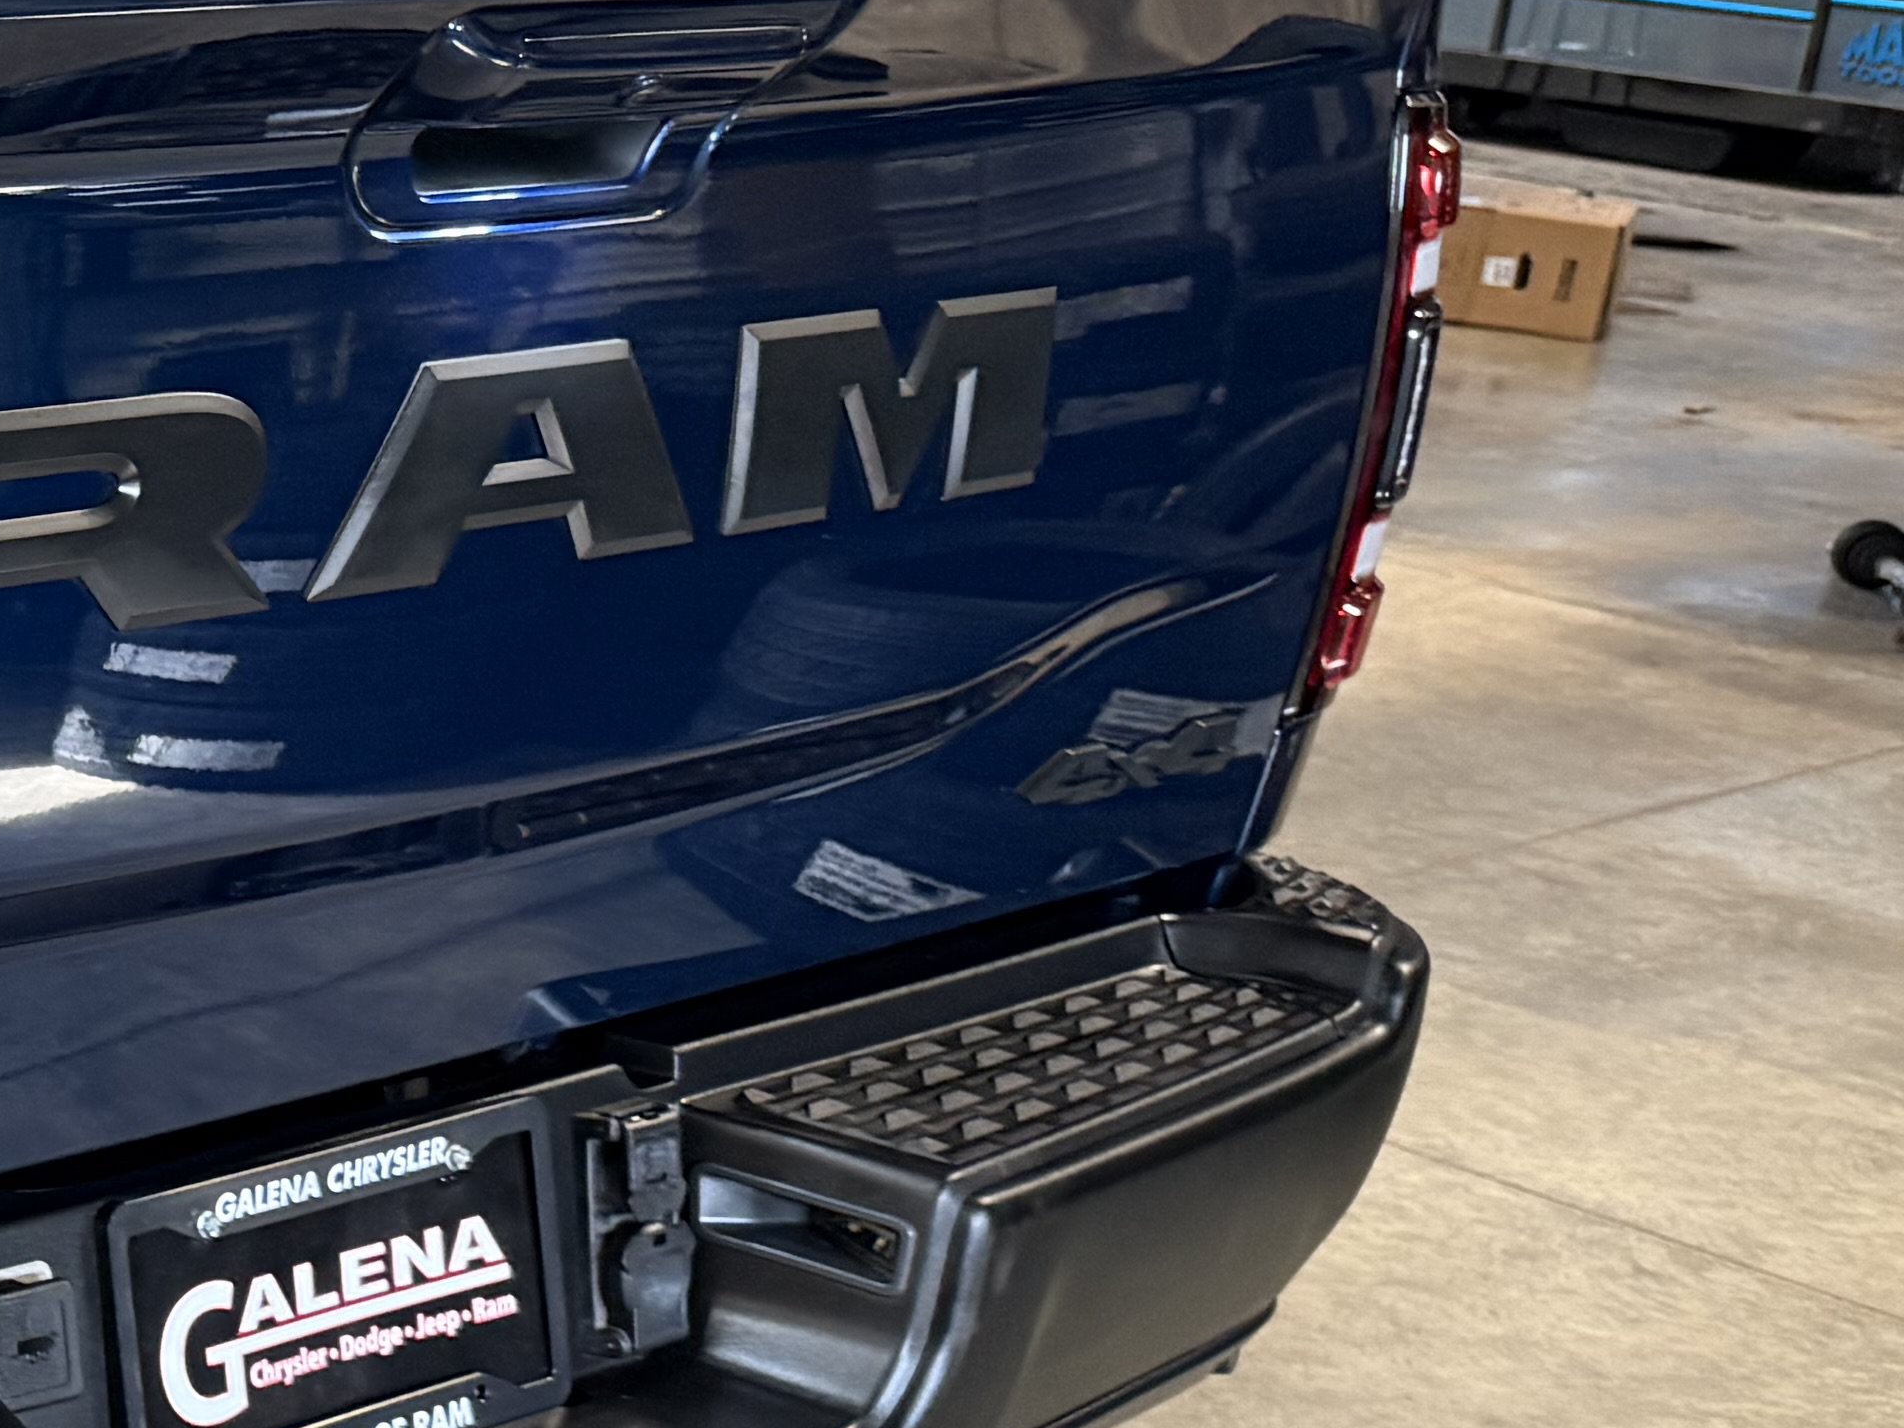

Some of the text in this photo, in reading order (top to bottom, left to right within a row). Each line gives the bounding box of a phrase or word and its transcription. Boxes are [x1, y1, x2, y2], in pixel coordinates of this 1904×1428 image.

[214, 1135, 449, 1224] GALENA CHRYSLER
[159, 1214, 507, 1428] GALENA
